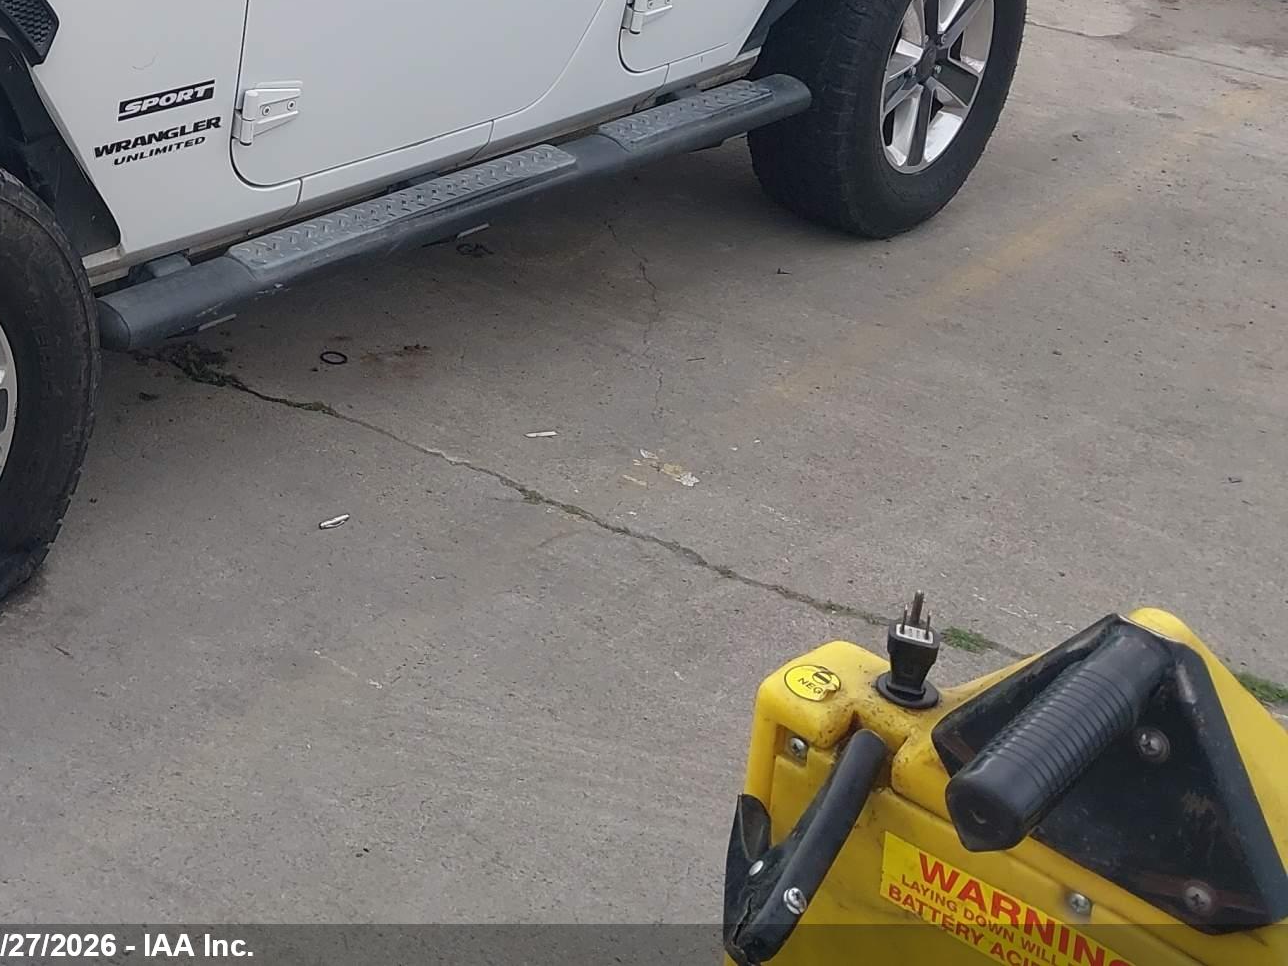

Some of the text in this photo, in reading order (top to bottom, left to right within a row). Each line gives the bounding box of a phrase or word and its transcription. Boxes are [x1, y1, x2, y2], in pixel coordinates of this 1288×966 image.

[119, 83, 214, 117] SPORT
[94, 116, 221, 158] WRANGLER
[114, 136, 206, 166] UNLIMITED
[797, 676, 824, 695] NEG
[888, 884, 1043, 966] BATTERY ACI
[901, 873, 959, 914] LAYING
[963, 909, 1015, 944] DOWN
[919, 851, 1136, 966] WARNIN
